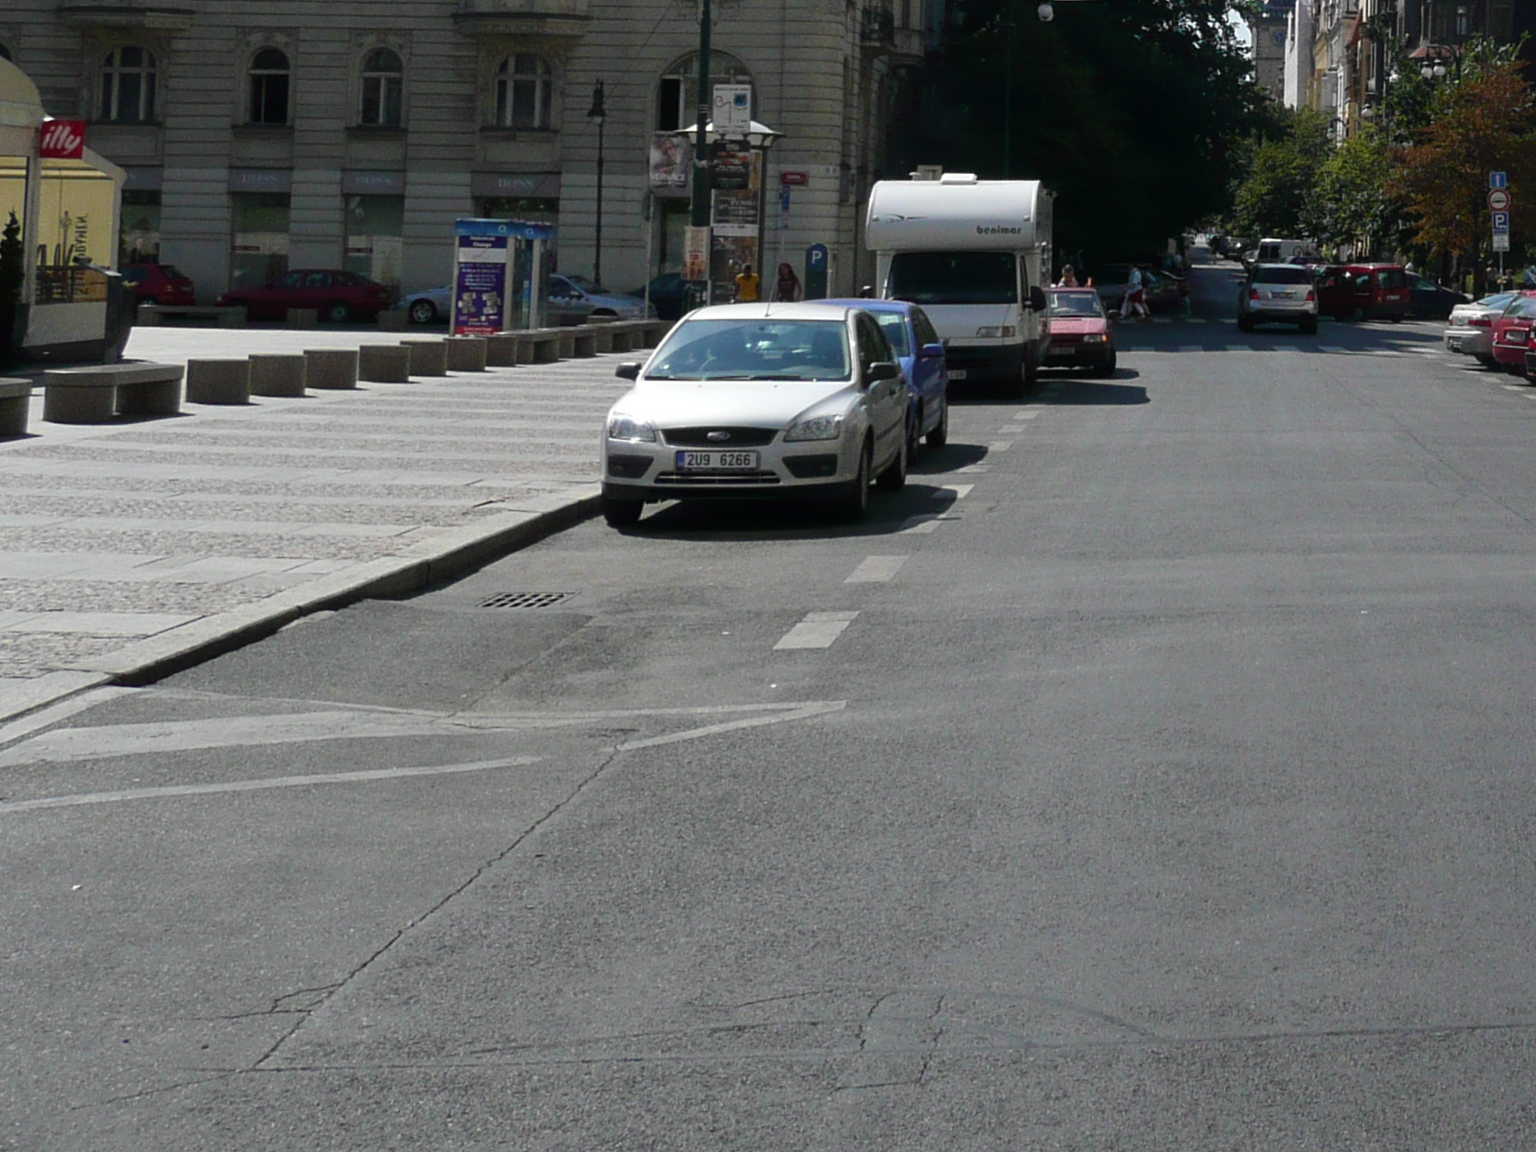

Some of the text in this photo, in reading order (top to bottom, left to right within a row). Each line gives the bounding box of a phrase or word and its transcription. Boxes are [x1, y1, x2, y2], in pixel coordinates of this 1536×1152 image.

[42, 124, 81, 155] illy
[976, 225, 1022, 234] benimar
[687, 454, 751, 466] 2U9 6266
